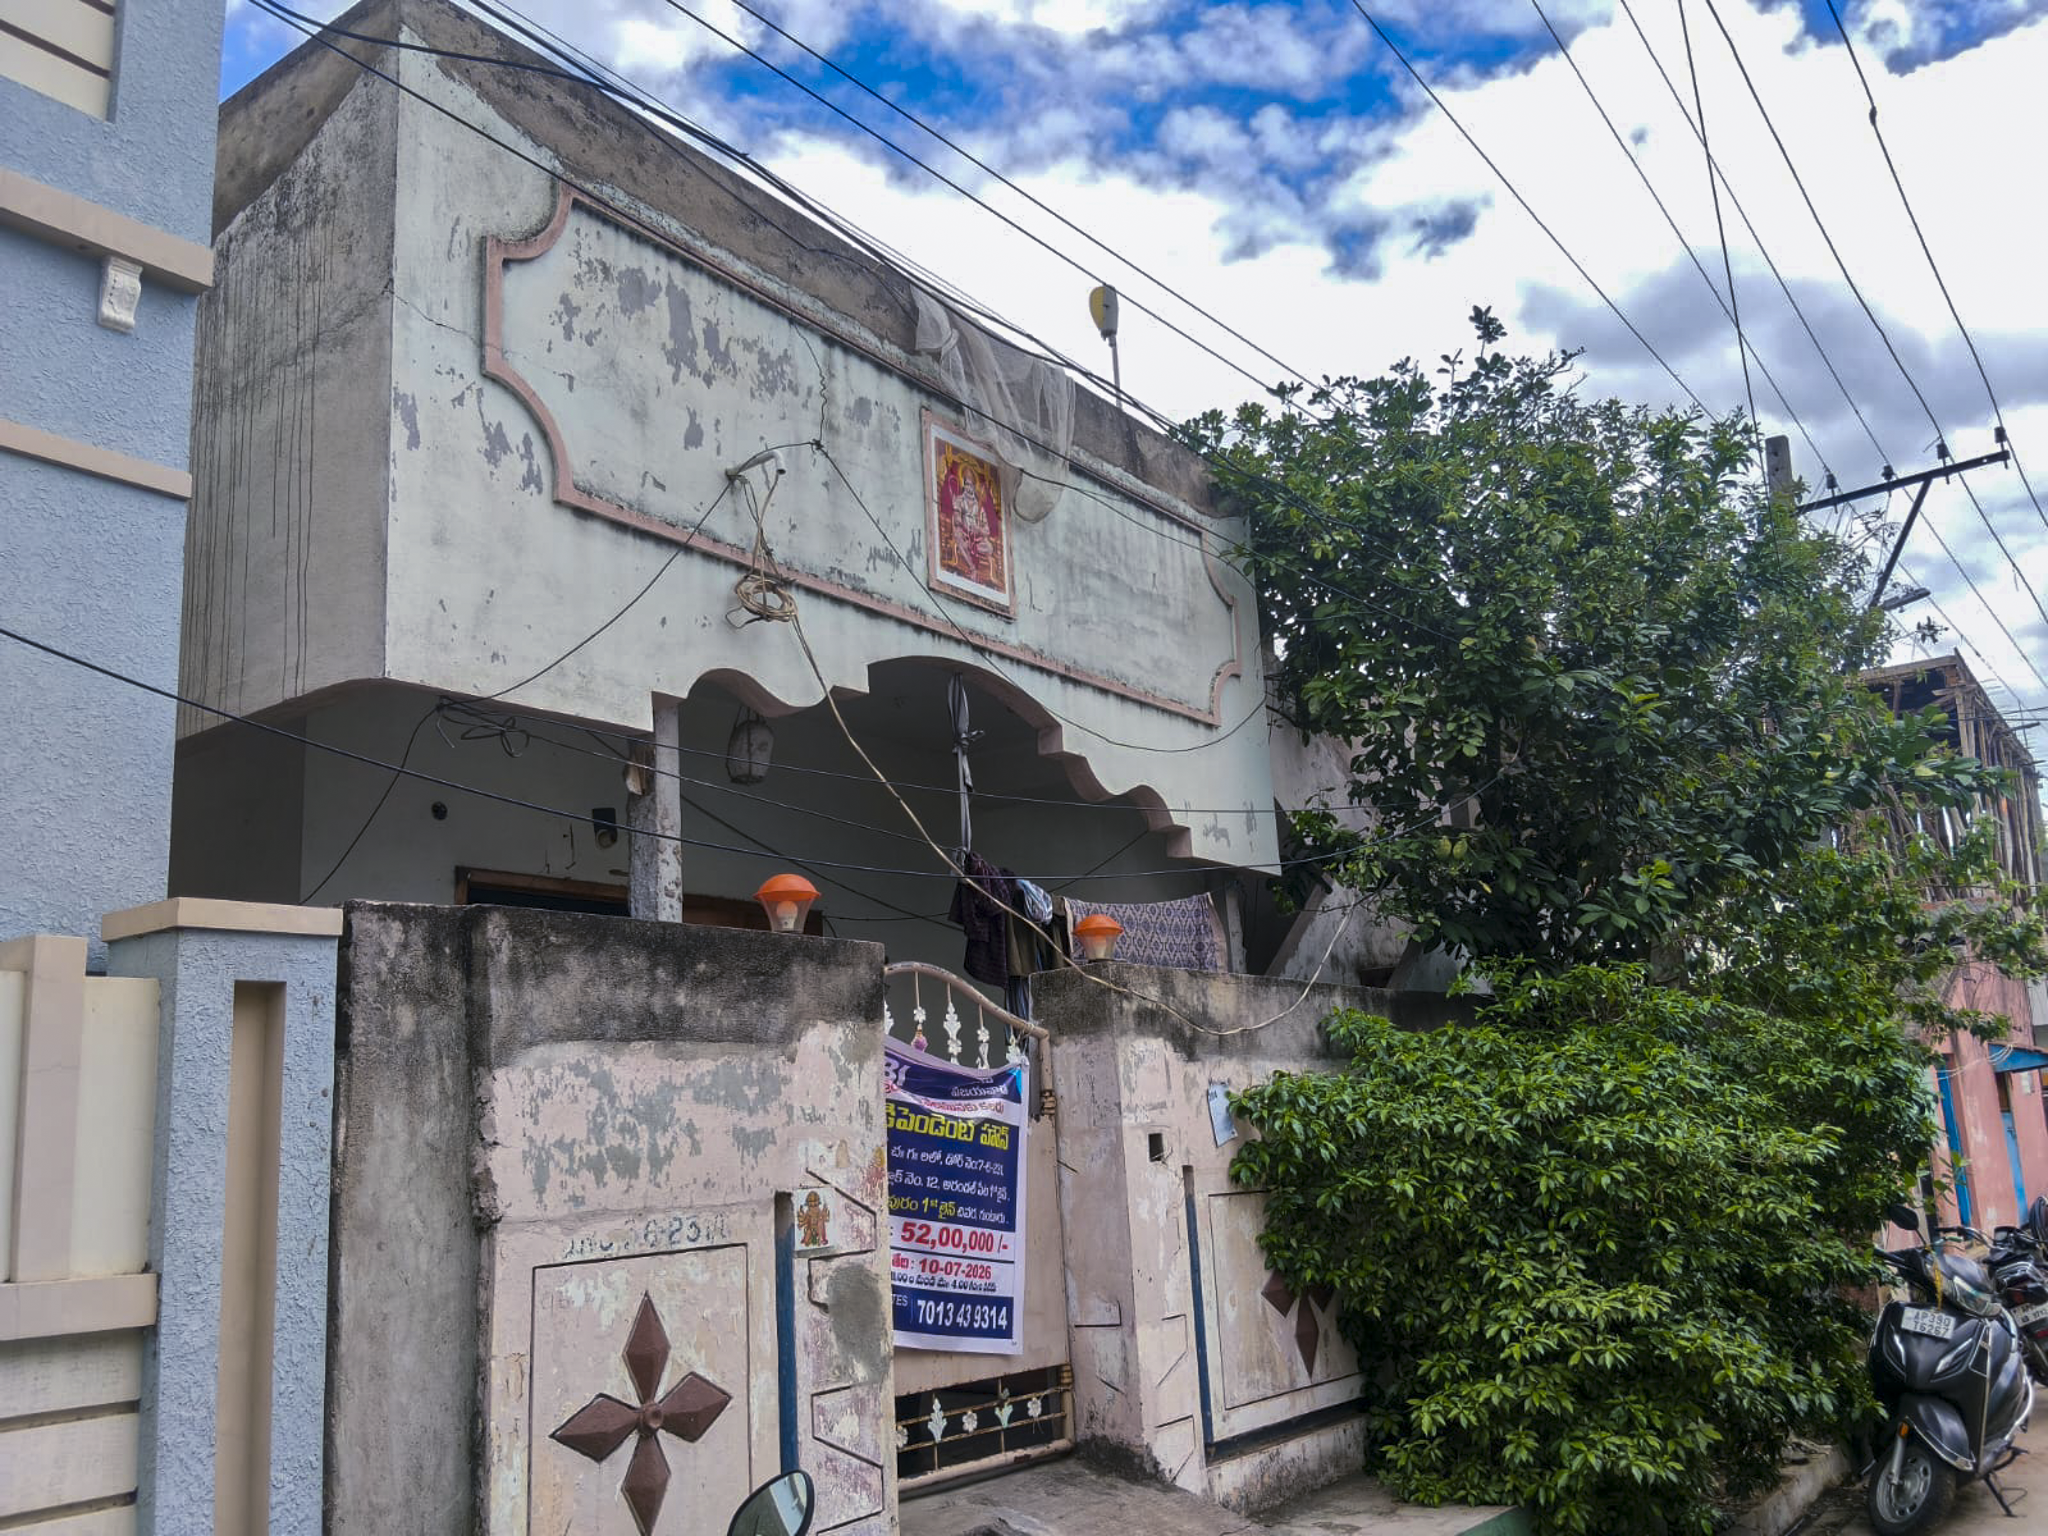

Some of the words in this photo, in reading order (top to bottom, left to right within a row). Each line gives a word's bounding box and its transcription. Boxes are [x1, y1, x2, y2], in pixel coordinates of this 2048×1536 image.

[980, 1123, 1009, 1151] హౌస్
[901, 1221, 994, 1253] 52,00,000
[919, 1258, 991, 1280] 10-07-2026
